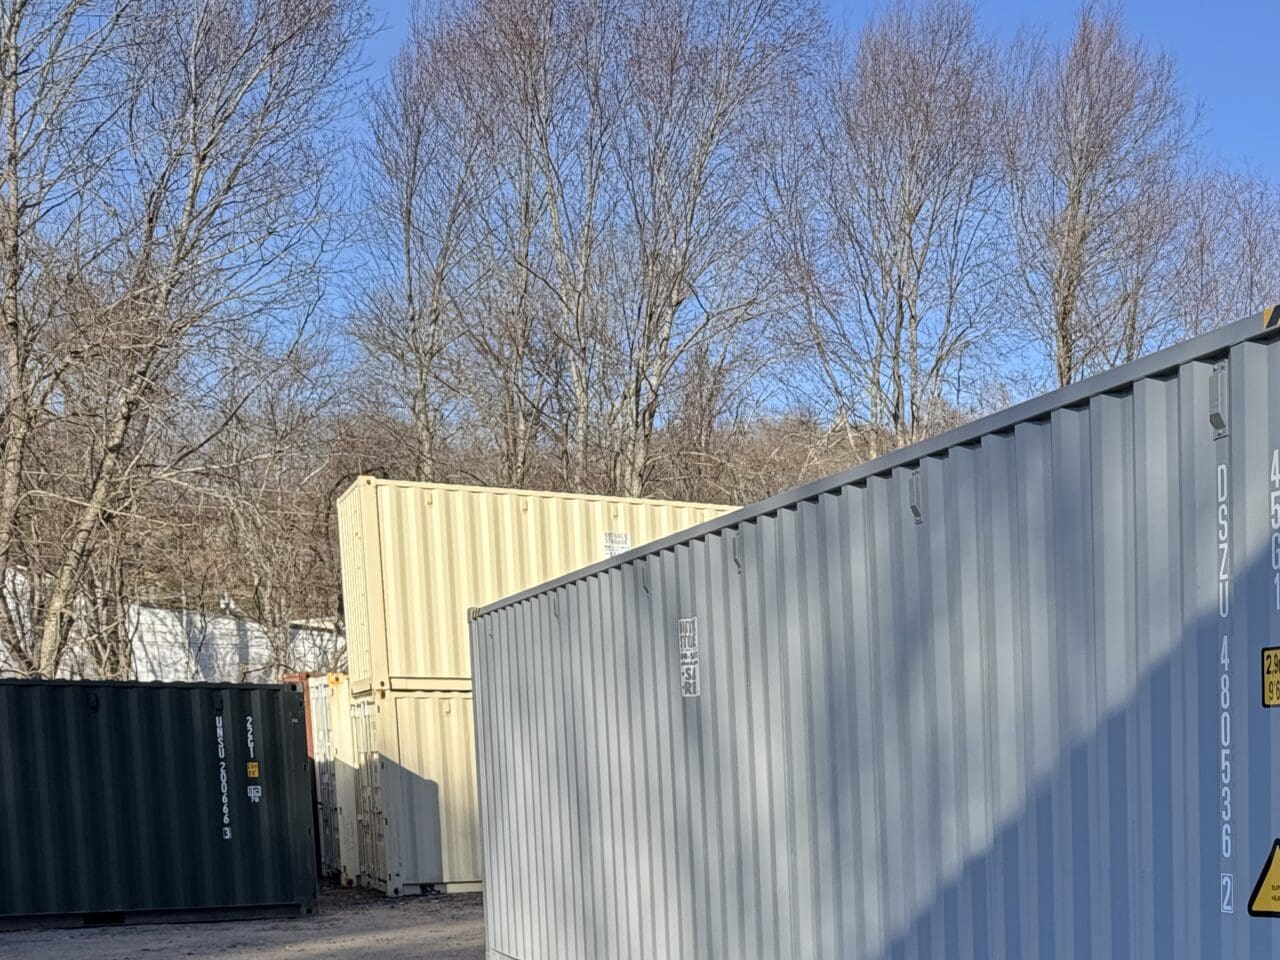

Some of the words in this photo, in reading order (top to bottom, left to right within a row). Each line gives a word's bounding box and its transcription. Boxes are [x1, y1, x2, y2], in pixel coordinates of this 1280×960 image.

[1217, 464, 1229, 618] DSZU
[246, 716, 254, 758] 22G1
[1220, 634, 1232, 858] 480536
[220, 761, 229, 825] 200666
[224, 827, 230, 839] 3
[1221, 874, 1232, 911] 2
